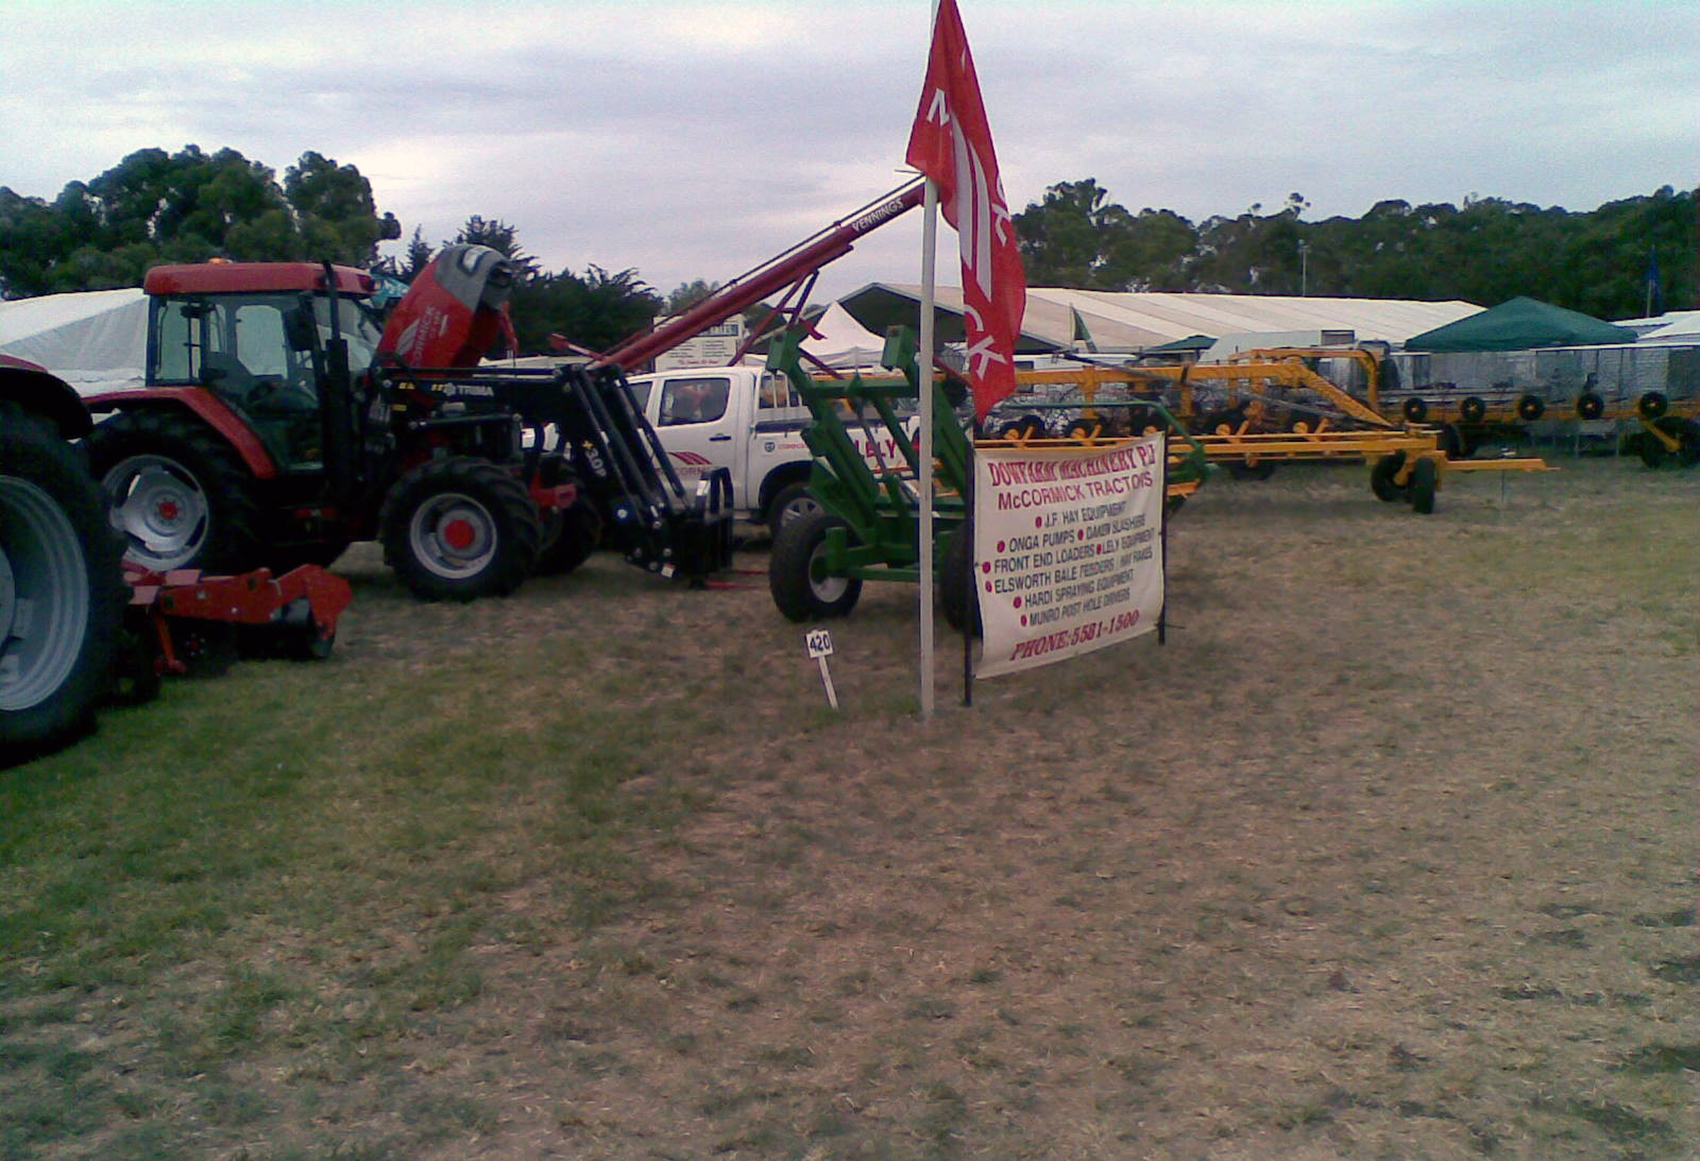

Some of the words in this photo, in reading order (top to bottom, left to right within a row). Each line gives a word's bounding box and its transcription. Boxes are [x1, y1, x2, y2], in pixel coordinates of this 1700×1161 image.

[852, 198, 904, 232] VENNINGS
[1060, 446, 1137, 480] MACHINERY
[998, 484, 1088, 510] McCORMICK
[1062, 511, 1080, 526] HAY
[1081, 501, 1127, 522] EQUIPMENT
[1008, 535, 1040, 553] ONGA
[1042, 529, 1076, 548] PUMPS
[993, 555, 1031, 574] FRONT
[1033, 552, 1054, 567] END
[1056, 544, 1096, 564] LOADERS
[1102, 538, 1121, 555] LELY
[994, 572, 1052, 594] ELSWORTH
[1054, 566, 1078, 584] BALE
[1025, 591, 1054, 609] HARDI
[1055, 580, 1095, 603] SPRAYING
[1096, 569, 1135, 592] EQUIPMENT
[1029, 607, 1061, 627] MUNRO
[1062, 601, 1083, 620] POST
[1083, 596, 1102, 613] HOLE
[810, 634, 831, 652] 420
